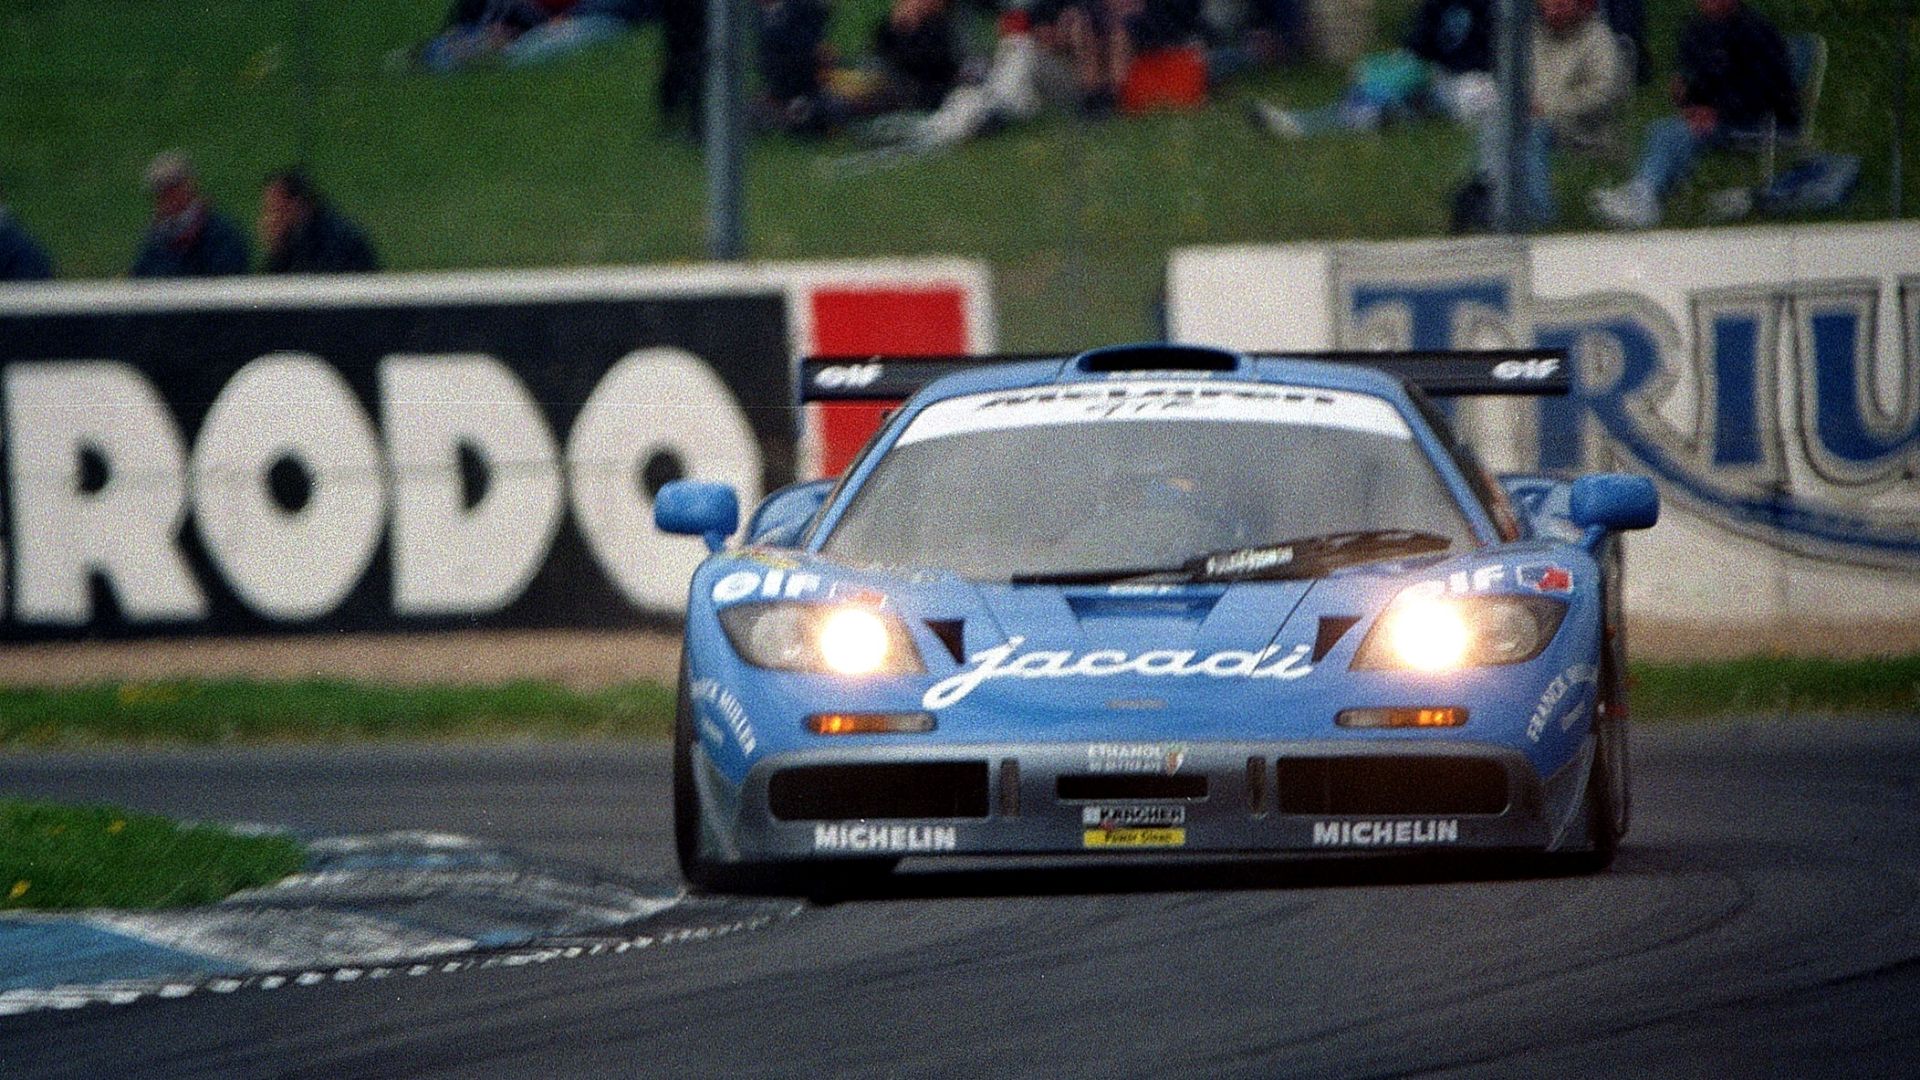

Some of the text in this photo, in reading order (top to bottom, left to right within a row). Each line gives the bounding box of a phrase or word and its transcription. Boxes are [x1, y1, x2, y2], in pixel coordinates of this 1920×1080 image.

[3, 346, 765, 623] RODO
[921, 634, 1314, 710] jacadi
[814, 825, 957, 850] MICHELIN
[1313, 819, 1459, 845] MICHELIN
